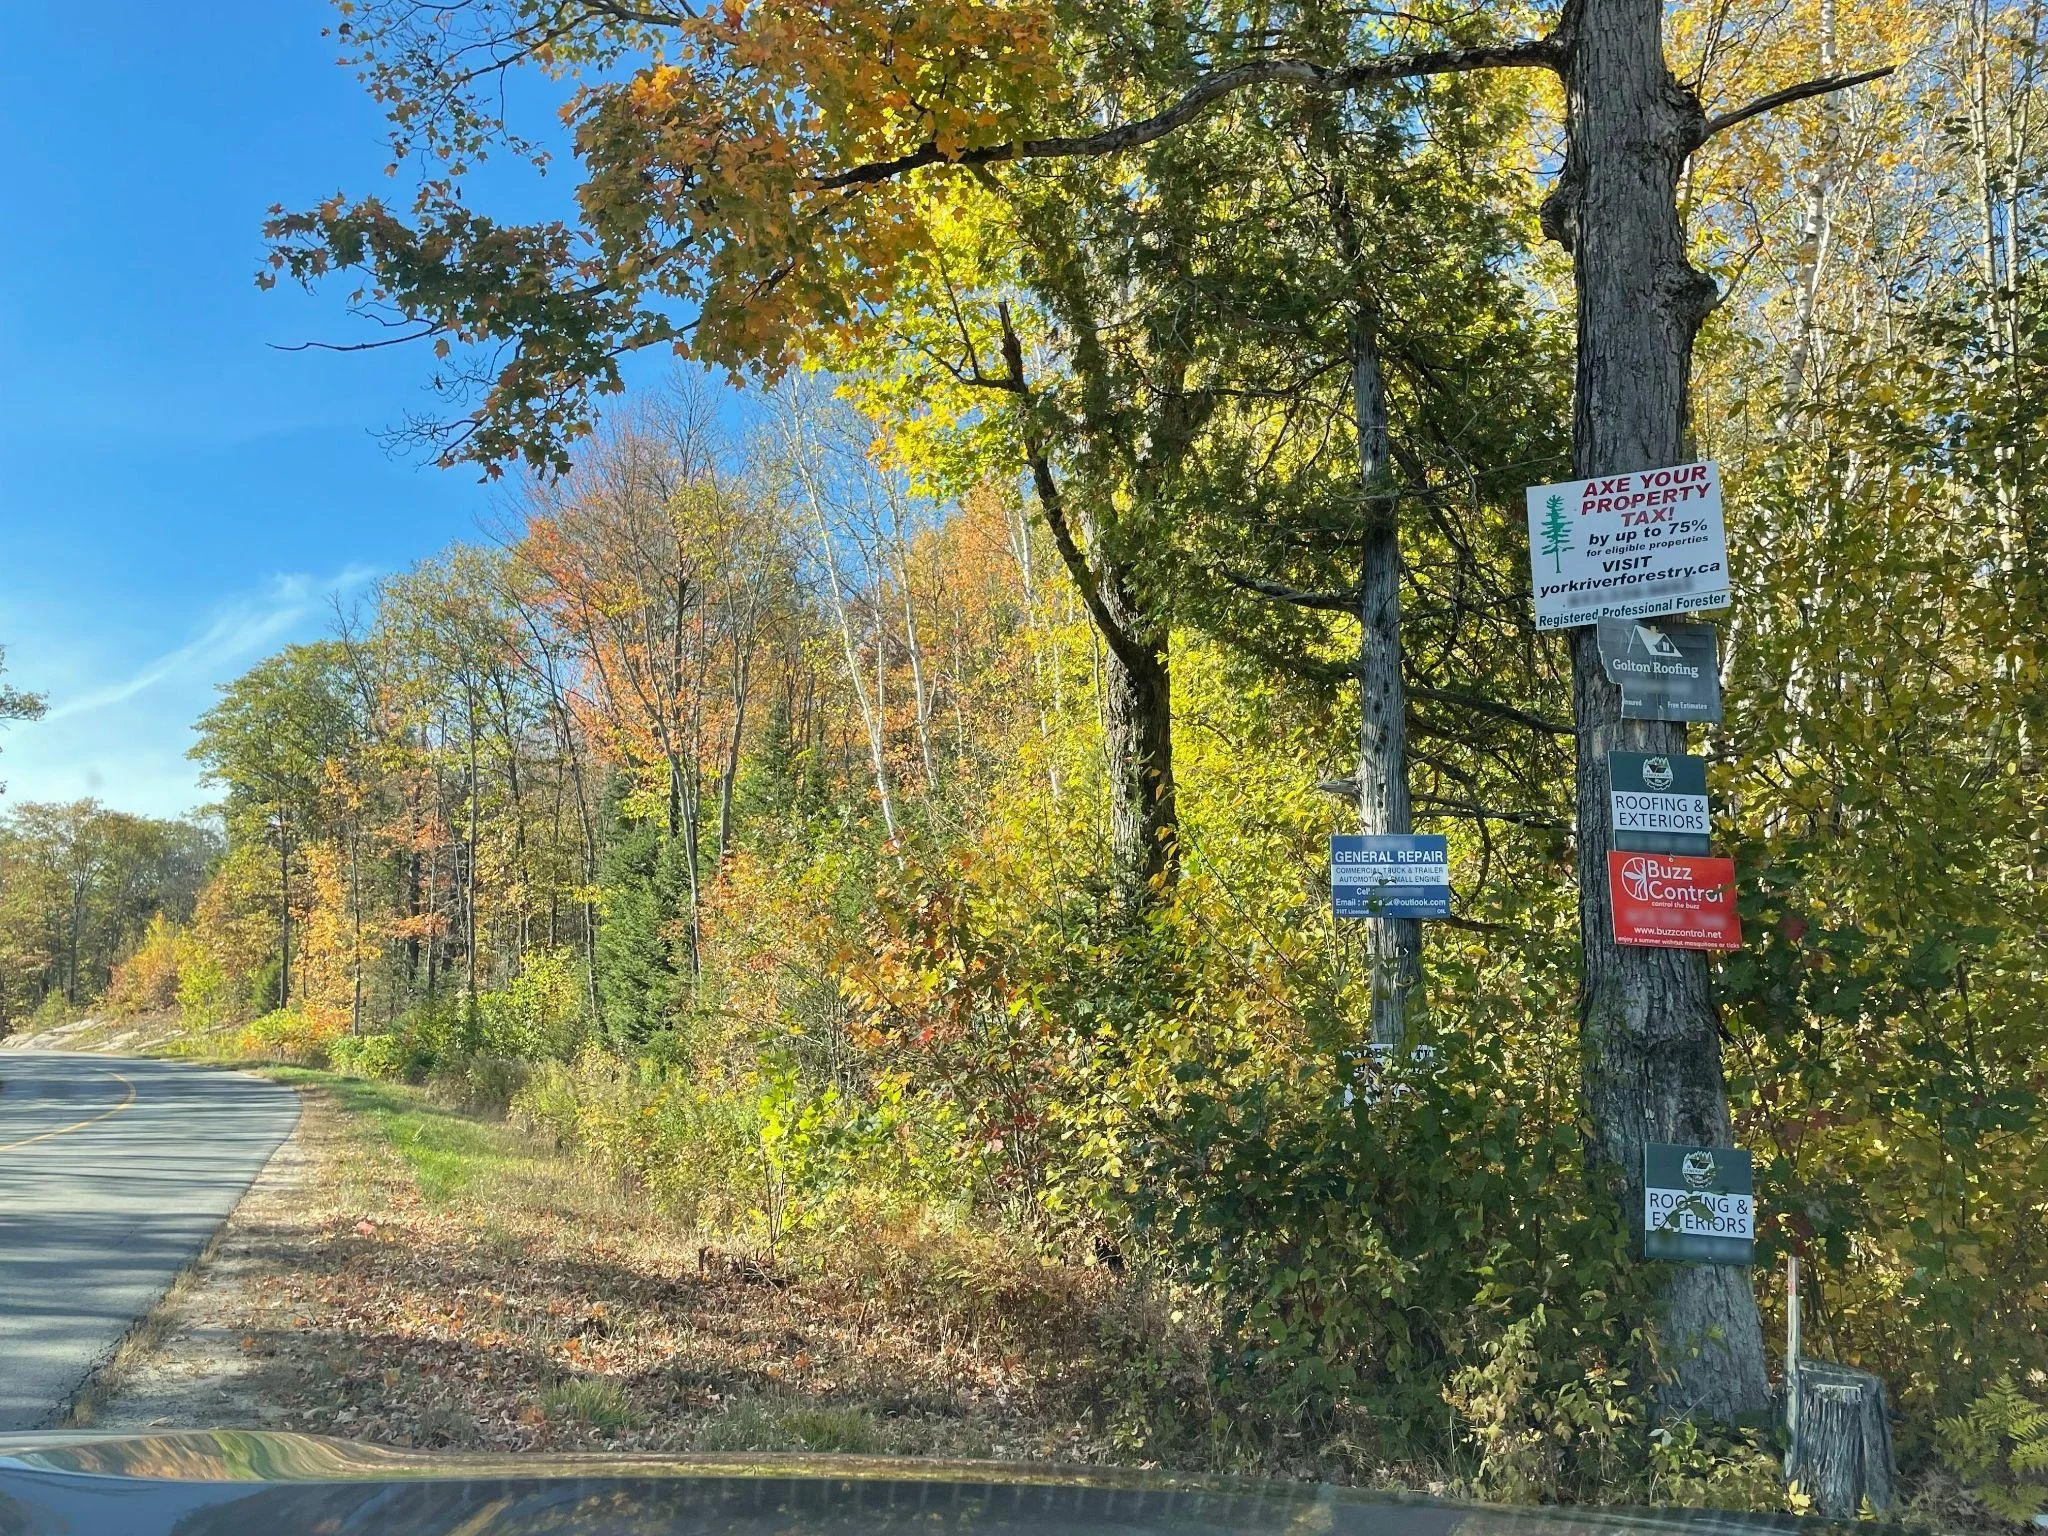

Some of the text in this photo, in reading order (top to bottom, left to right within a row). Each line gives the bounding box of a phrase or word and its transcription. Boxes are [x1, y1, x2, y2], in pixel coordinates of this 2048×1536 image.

[1582, 465, 1707, 497] AXE YOUR
[1581, 482, 1711, 515] PROPERTY
[1620, 507, 1675, 527] TAX!
[1588, 519, 1708, 546] by up to 75%
[1586, 535, 1708, 557] for eligible properties
[1602, 555, 1652, 573] VISIT
[1540, 561, 1720, 597] yorkriverforestry.ca
[1539, 593, 1726, 628] Registered Professional Forester
[1612, 659, 1699, 678] Golton Roofing
[1615, 795, 1704, 813] ROOFING &
[1619, 812, 1704, 830] EXTERIORS
[1335, 851, 1444, 862] GENERAL REPAIR
[1647, 860, 1693, 880] Buzz
[1648, 881, 1724, 903] Control
[1335, 898, 1356, 906] Email
[1651, 900, 1700, 910] control the buzz
[1633, 925, 1722, 939] www.buzzcontrol.net
[1736, 1199, 1748, 1215] &
